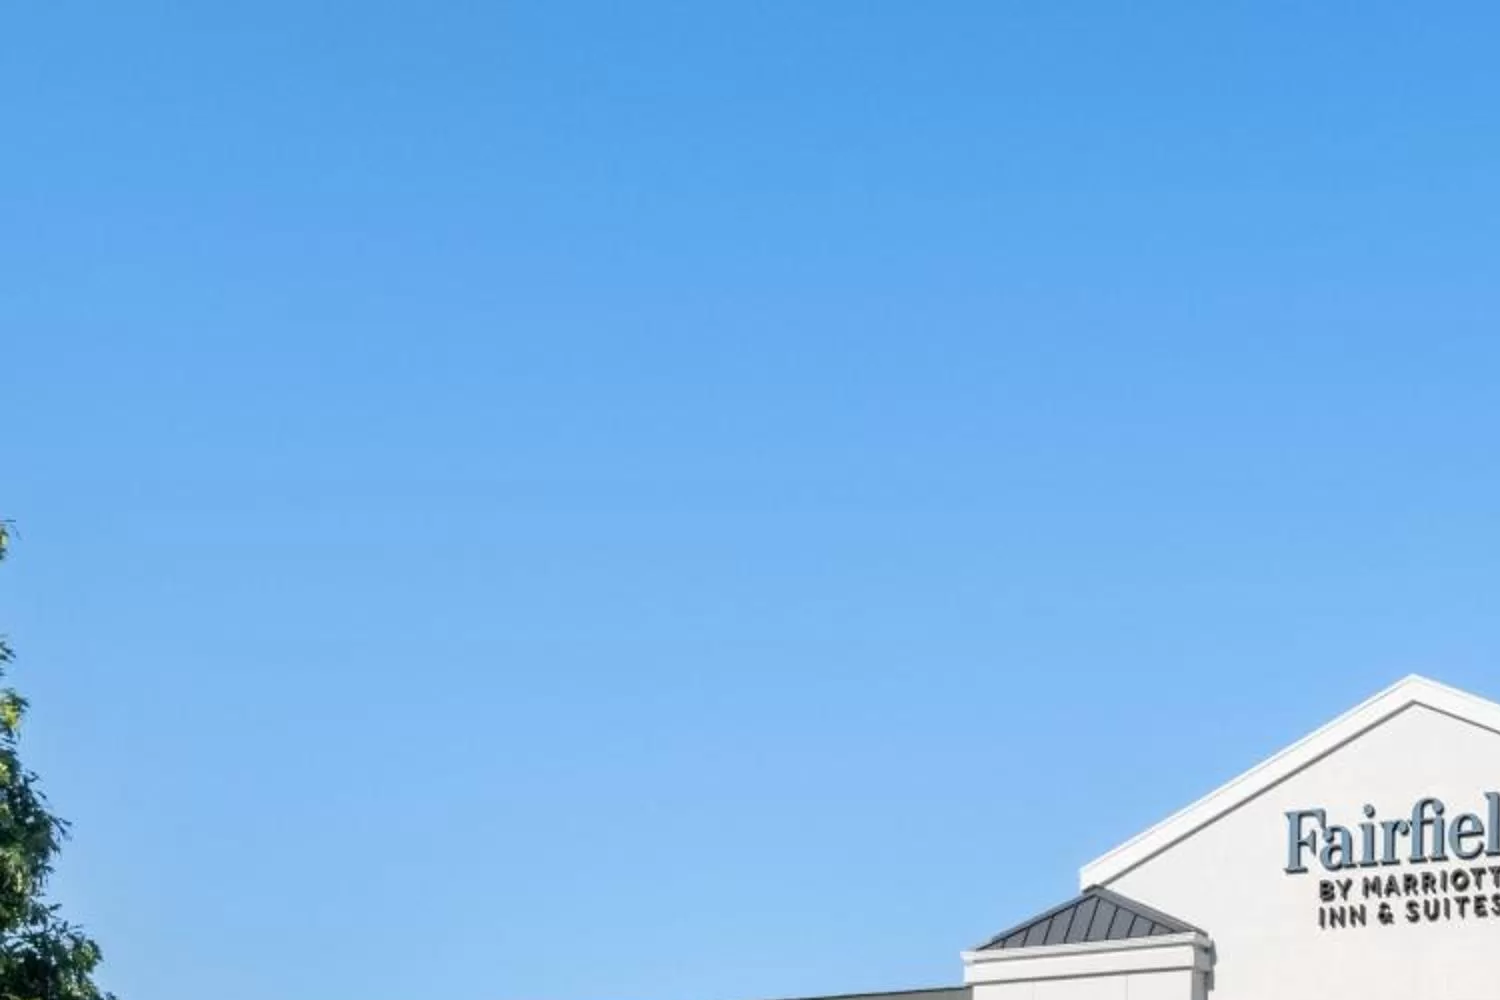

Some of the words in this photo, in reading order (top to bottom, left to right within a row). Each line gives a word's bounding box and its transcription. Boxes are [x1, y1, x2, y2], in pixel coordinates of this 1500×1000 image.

[1318, 878, 1353, 902] BY
[1317, 903, 1367, 930] INN
[1378, 902, 1394, 925] &
